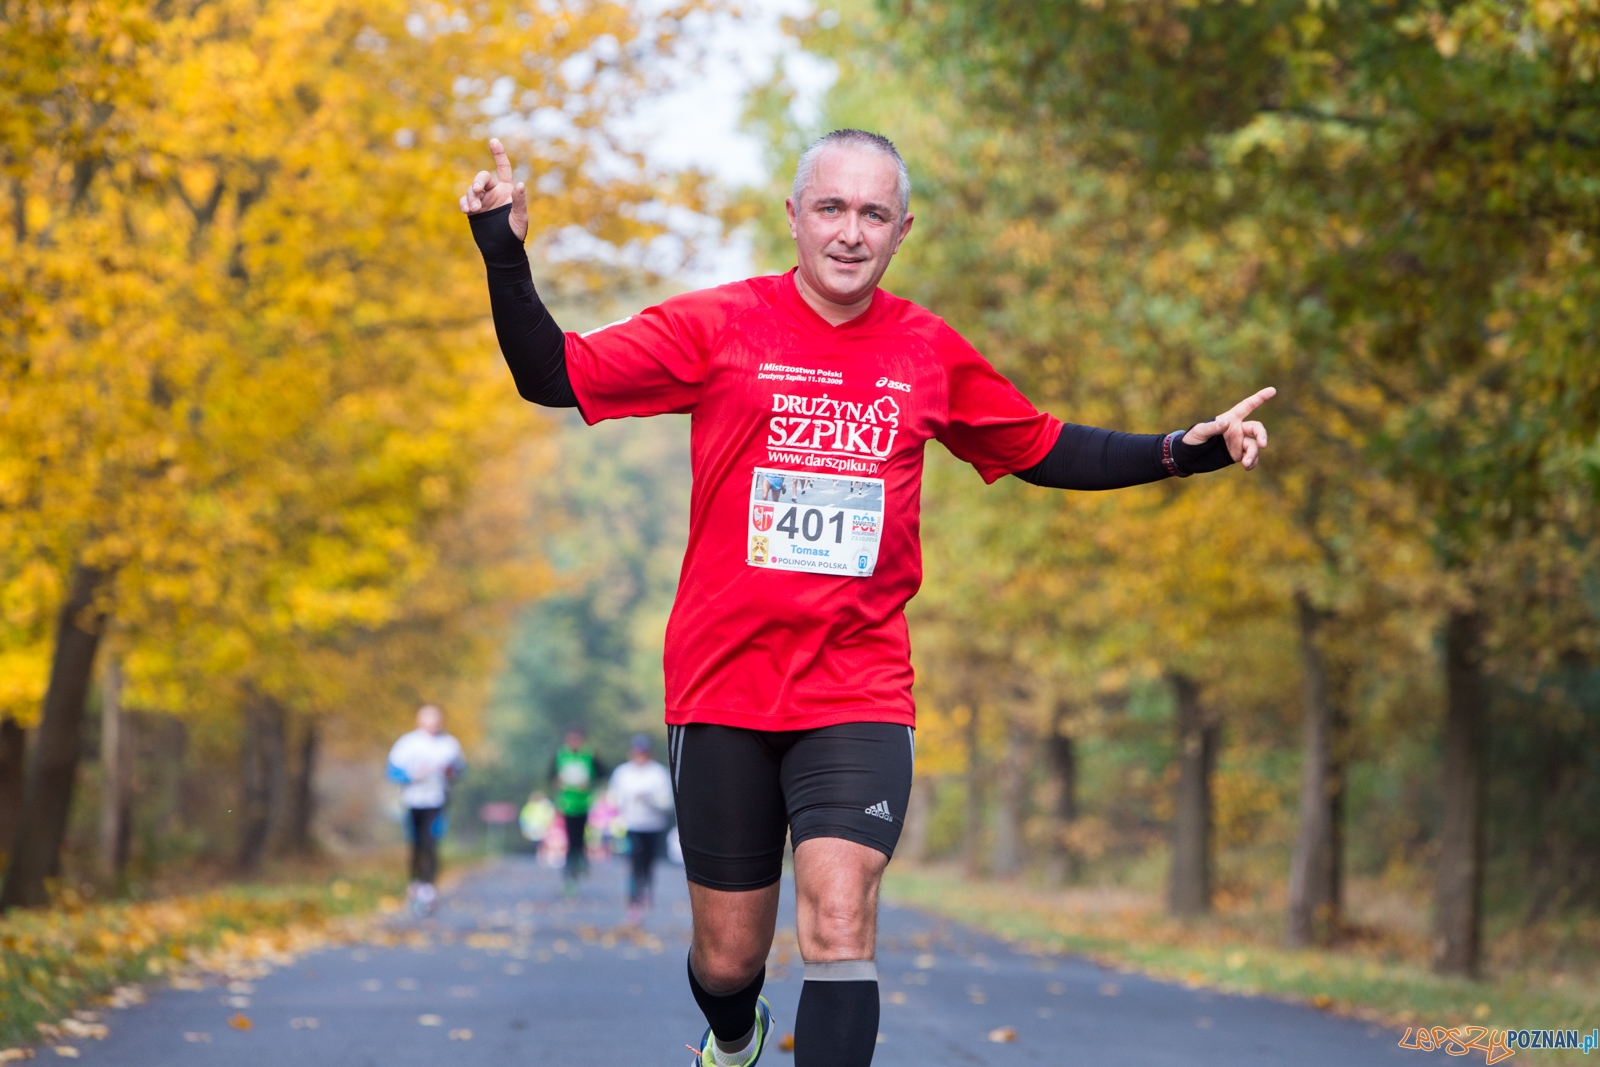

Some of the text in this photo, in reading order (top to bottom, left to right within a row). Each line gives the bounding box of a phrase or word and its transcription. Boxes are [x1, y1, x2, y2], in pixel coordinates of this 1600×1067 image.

[759, 363, 843, 378] I Mistrzostwa Polski
[758, 373, 843, 385] Drużyny Szpiku 11.10.2009
[772, 393, 877, 424] DRUŻYNA
[767, 416, 898, 457] SZPIKU
[776, 506, 844, 544] 401
[790, 544, 830, 557] Tomasz
[778, 557, 816, 567] POLINOVA
[818, 561, 848, 570] POLSKA
[864, 807, 893, 822] adidas
